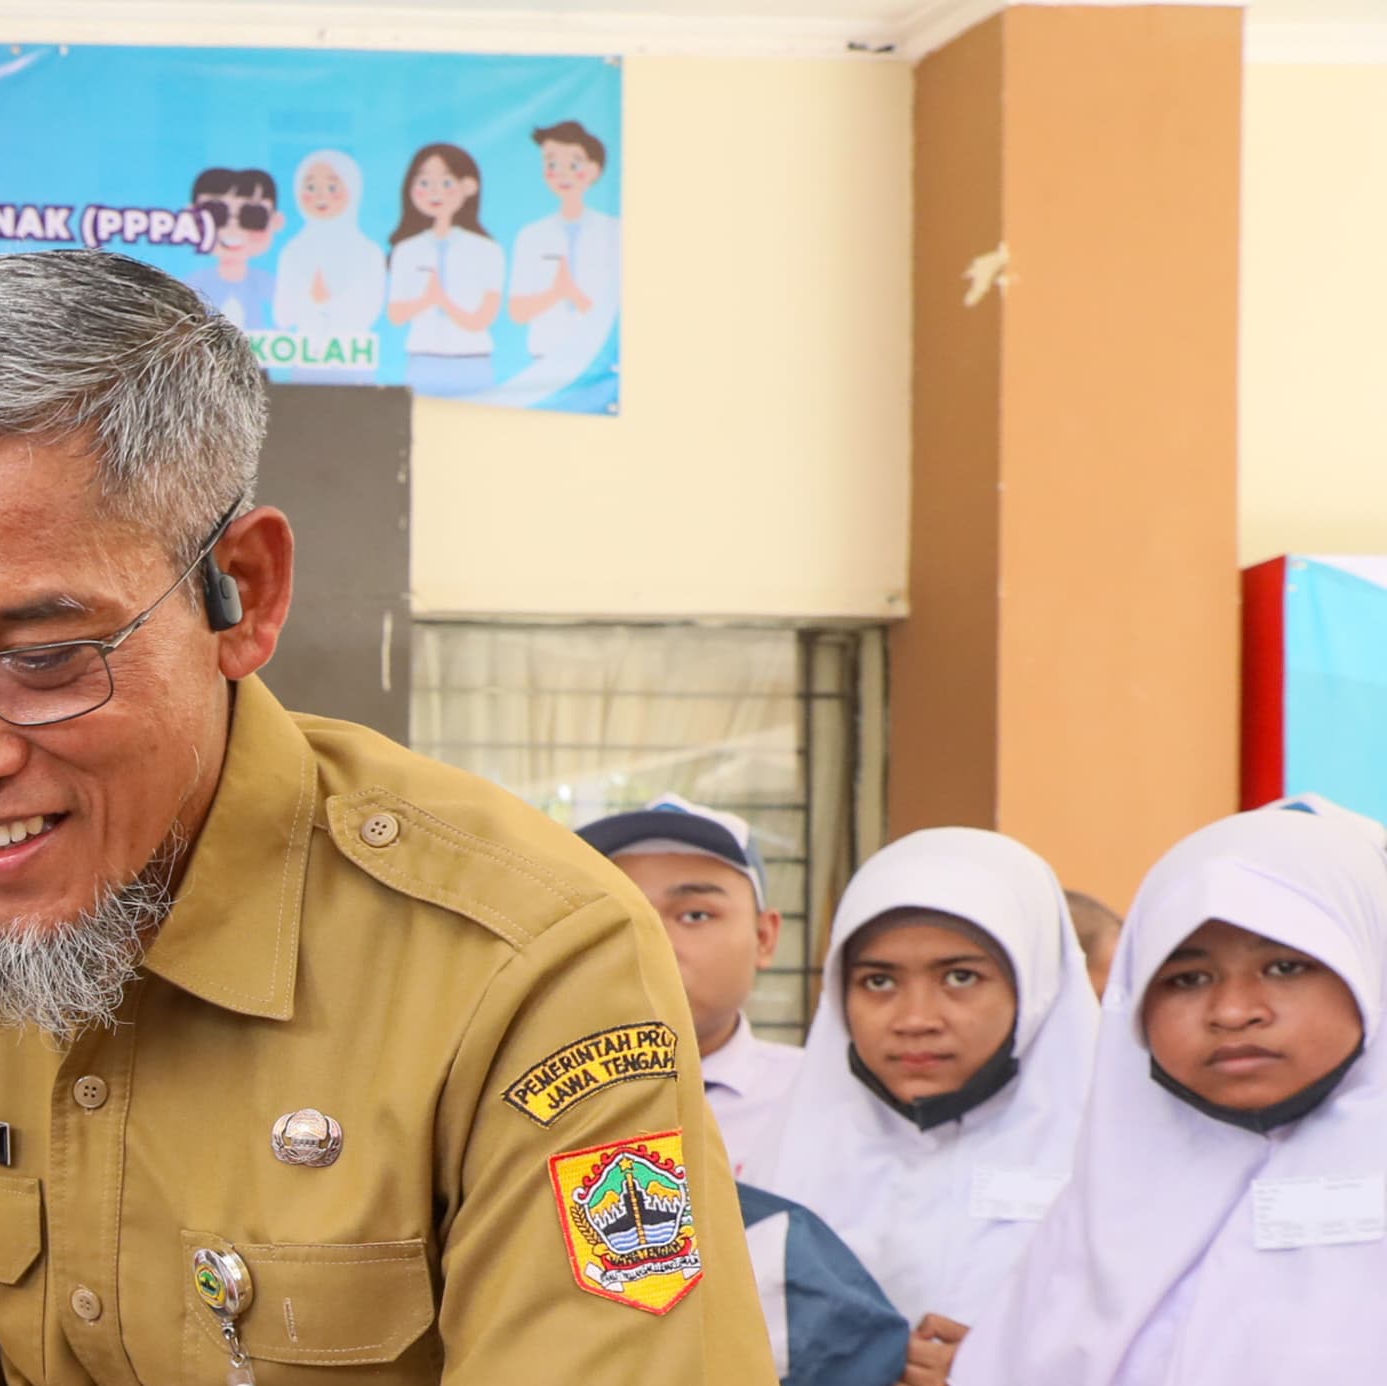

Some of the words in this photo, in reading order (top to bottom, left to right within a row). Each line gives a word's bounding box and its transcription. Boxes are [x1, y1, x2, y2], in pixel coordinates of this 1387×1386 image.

[82, 206, 216, 252] (PPPA)
[248, 336, 374, 364] KOLAH
[515, 1032, 632, 1104] PEMERINTAH
[548, 1070, 600, 1109] JAWA
[601, 1050, 676, 1077] TENGAH
